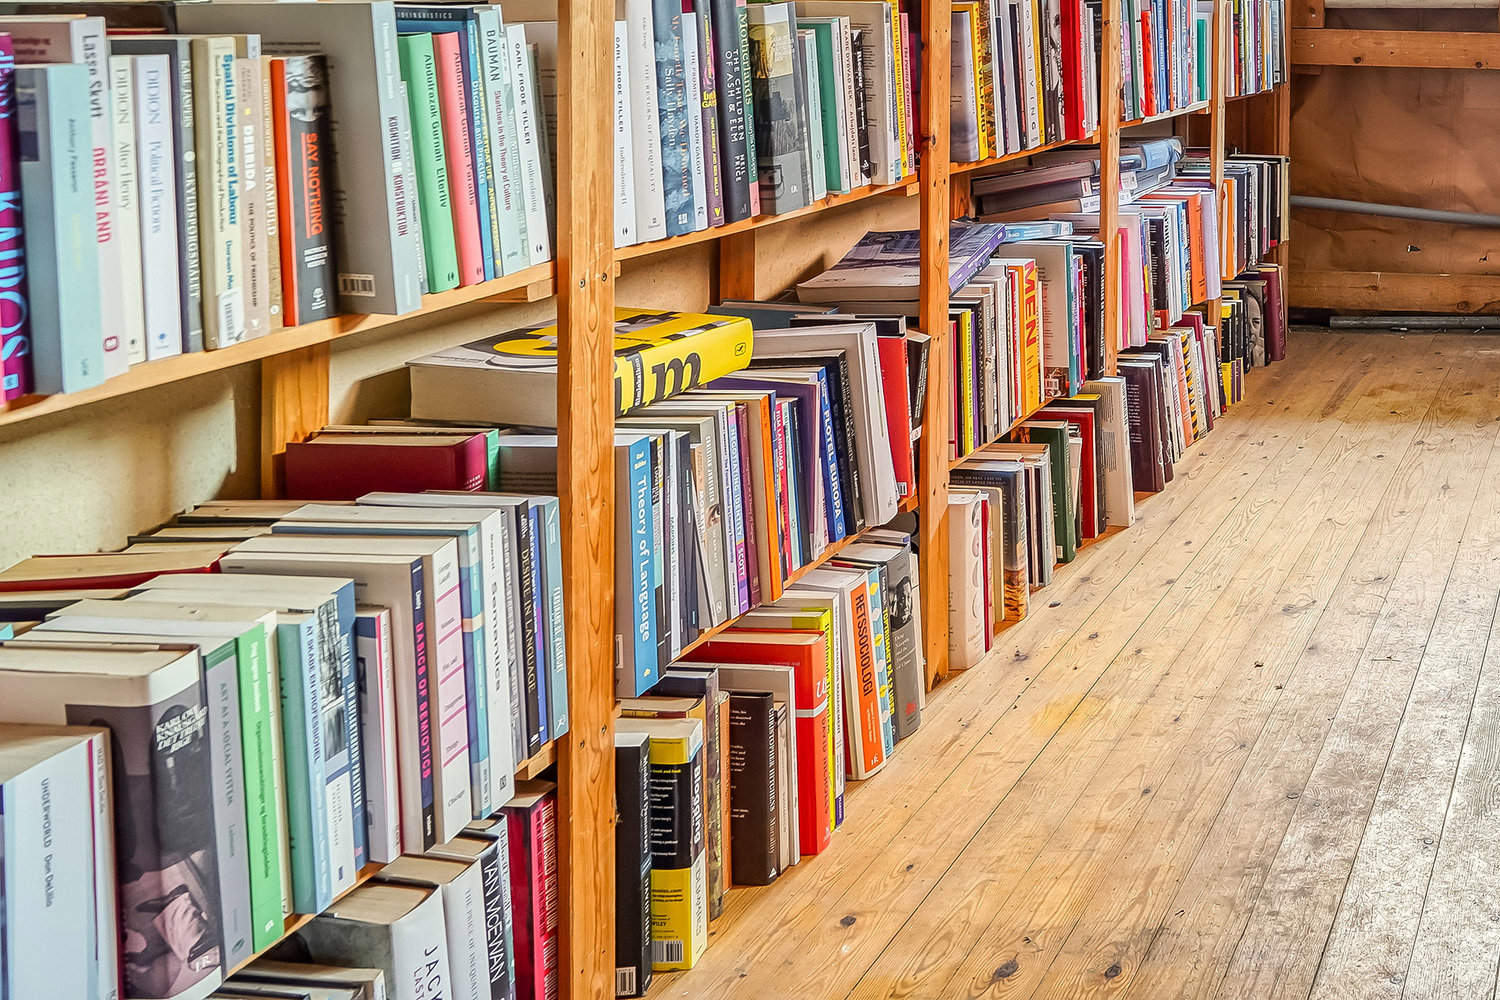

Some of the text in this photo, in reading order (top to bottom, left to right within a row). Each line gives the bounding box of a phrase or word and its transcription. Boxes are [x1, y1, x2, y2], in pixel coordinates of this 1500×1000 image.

[222, 54, 233, 100] Spatial
[486, 29, 500, 81] BAUMAN
[739, 13, 753, 106] Motherlands
[181, 60, 193, 128] KARL JASPERS
[472, 80, 482, 125] Discourse
[518, 73, 526, 106] FRODE
[522, 108, 531, 146] TILLER
[645, 86, 653, 119] RETURN
[663, 68, 677, 147] Sally Hayden
[735, 78, 745, 141] CHILDREN
[116, 69, 134, 210] DIDION After Henry
[146, 69, 164, 234] DIDION Political Fictions
[225, 102, 236, 164] Divisions
[243, 125, 256, 191] DERRIDA
[306, 132, 318, 161] SAY
[388, 115, 401, 160] KOGNITION
[424, 53, 447, 209] Abdulrazak Gurnah Efterliv
[476, 146, 486, 184] Practice
[265, 165, 276, 235] SKAMFULD
[527, 159, 538, 213] Indkredsning
[648, 139, 657, 193] INEQUALITY
[228, 180, 238, 225] Labour
[308, 166, 323, 236] NOTHING
[393, 174, 408, 236] KONSTRUKTION
[1024, 261, 1036, 348] MEN
[730, 428, 743, 539] NEGOTIATING IDENTITY
[823, 409, 842, 518] FLOTEL EUROPA
[521, 548, 532, 597] DESIRE
[635, 474, 652, 641] Theory of Language
[308, 639, 317, 672] SKABE
[525, 619, 536, 694] LANGUAGE
[854, 593, 873, 697] RETSSOCIOLOGI
[882, 606, 893, 664] TOPTRIMMET
[311, 690, 320, 764] PROFESSIONEL
[415, 621, 431, 779] BASICS OF SEMIOTICS
[768, 708, 777, 855] CHRISTOPHER HITCHENS Mortality
[821, 716, 831, 814] DAVID NICHOLLS
[542, 802, 555, 820] THE
[692, 764, 703, 844] Blogging
[41, 778, 55, 907] UNDERWORLD Don DeLillo
[542, 819, 556, 874] UNFINISHED
[482, 860, 501, 894] IAN
[545, 874, 558, 931] REVOLUTION
[485, 898, 505, 982] McEWAN
